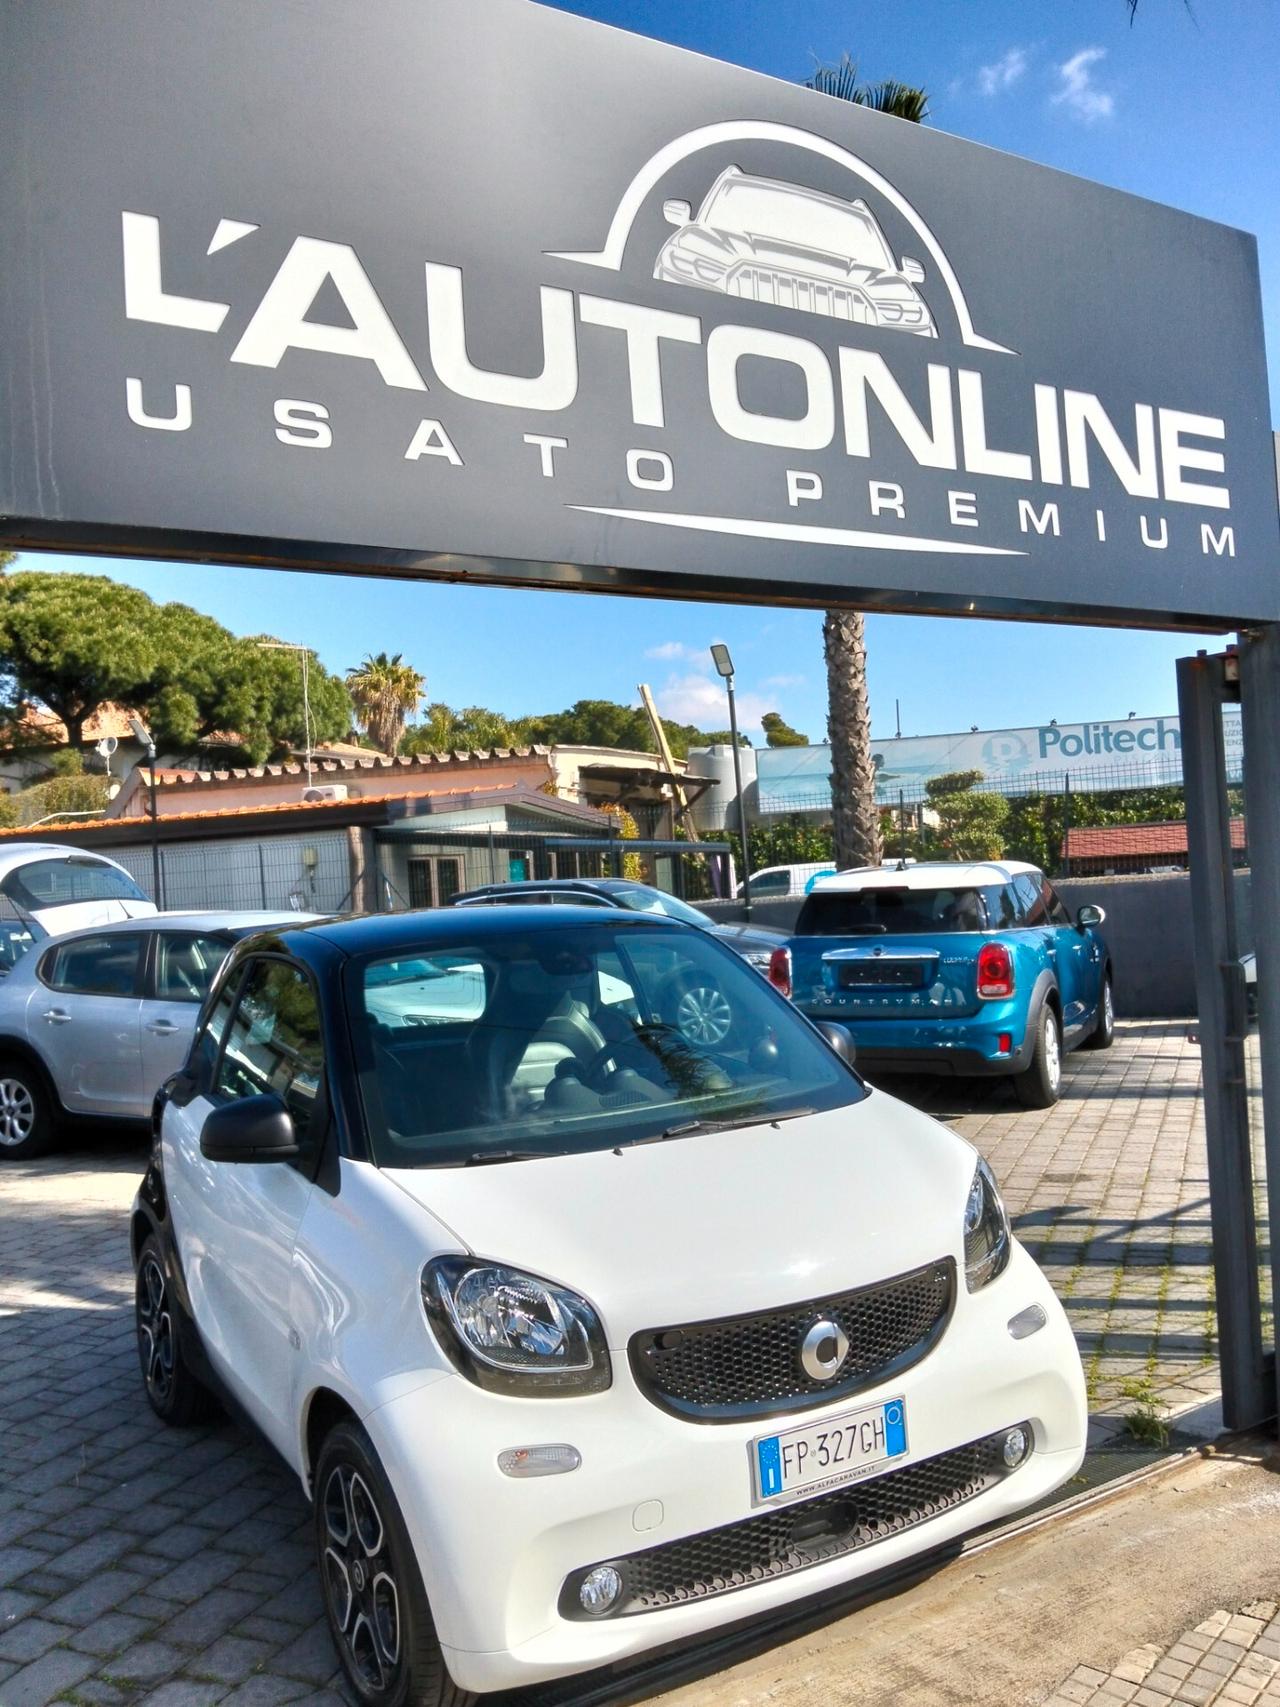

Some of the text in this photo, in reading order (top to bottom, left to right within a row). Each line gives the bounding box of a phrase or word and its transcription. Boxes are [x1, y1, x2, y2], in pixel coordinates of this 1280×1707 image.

[122, 210, 1230, 509] L'AUTONLINE
[126, 377, 1236, 557] USATO PREMIUM
[1038, 719, 1181, 759] Politech
[782, 1416, 885, 1478] FP 327GH
